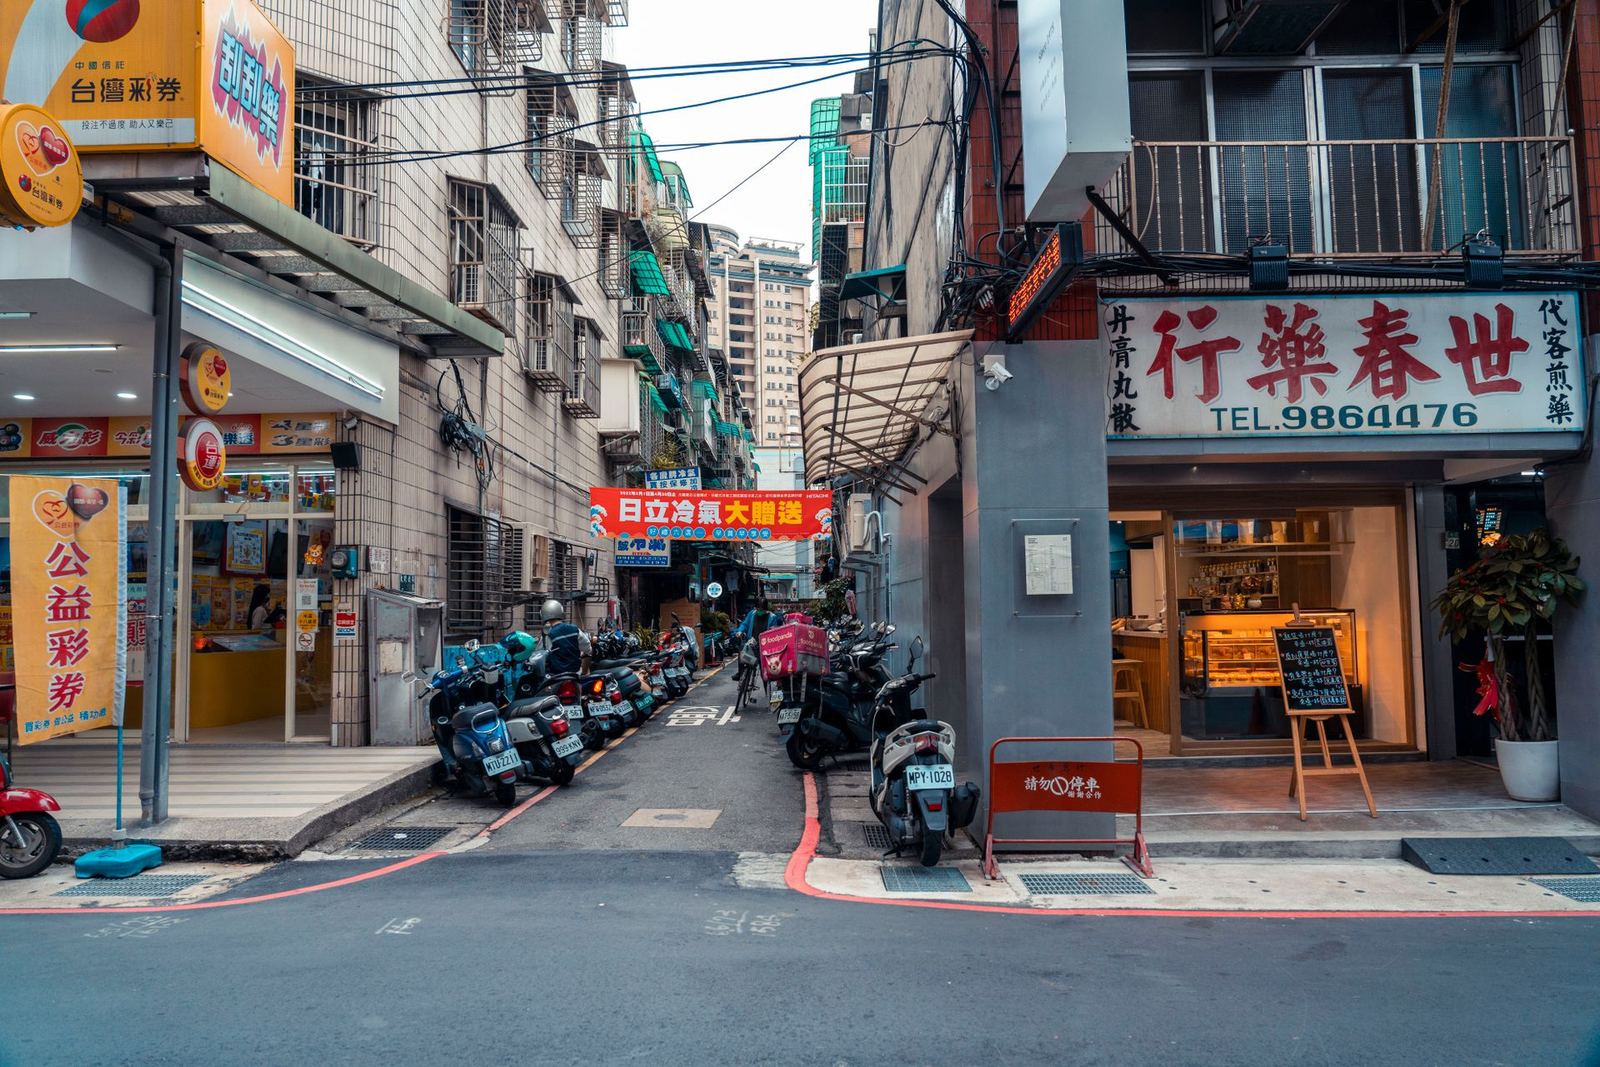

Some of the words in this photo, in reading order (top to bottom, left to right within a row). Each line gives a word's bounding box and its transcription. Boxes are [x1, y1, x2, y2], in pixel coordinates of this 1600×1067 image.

[75, 61, 125, 70] 中國信託
[71, 76, 182, 103] 台灣彩券
[218, 31, 281, 146] 刮刮樂
[82, 120, 125, 130] 投注不過度
[130, 119, 174, 129] 助人又樂己
[1107, 304, 1140, 433] 丹膏丸散
[1538, 298, 1574, 425] 代客煎藥
[619, 498, 803, 526] 日立冷氣大贈送
[47, 541, 91, 713] 公益彩券
[767, 632, 793, 643] foodpanda
[556, 739, 581, 755] 999-KNV
